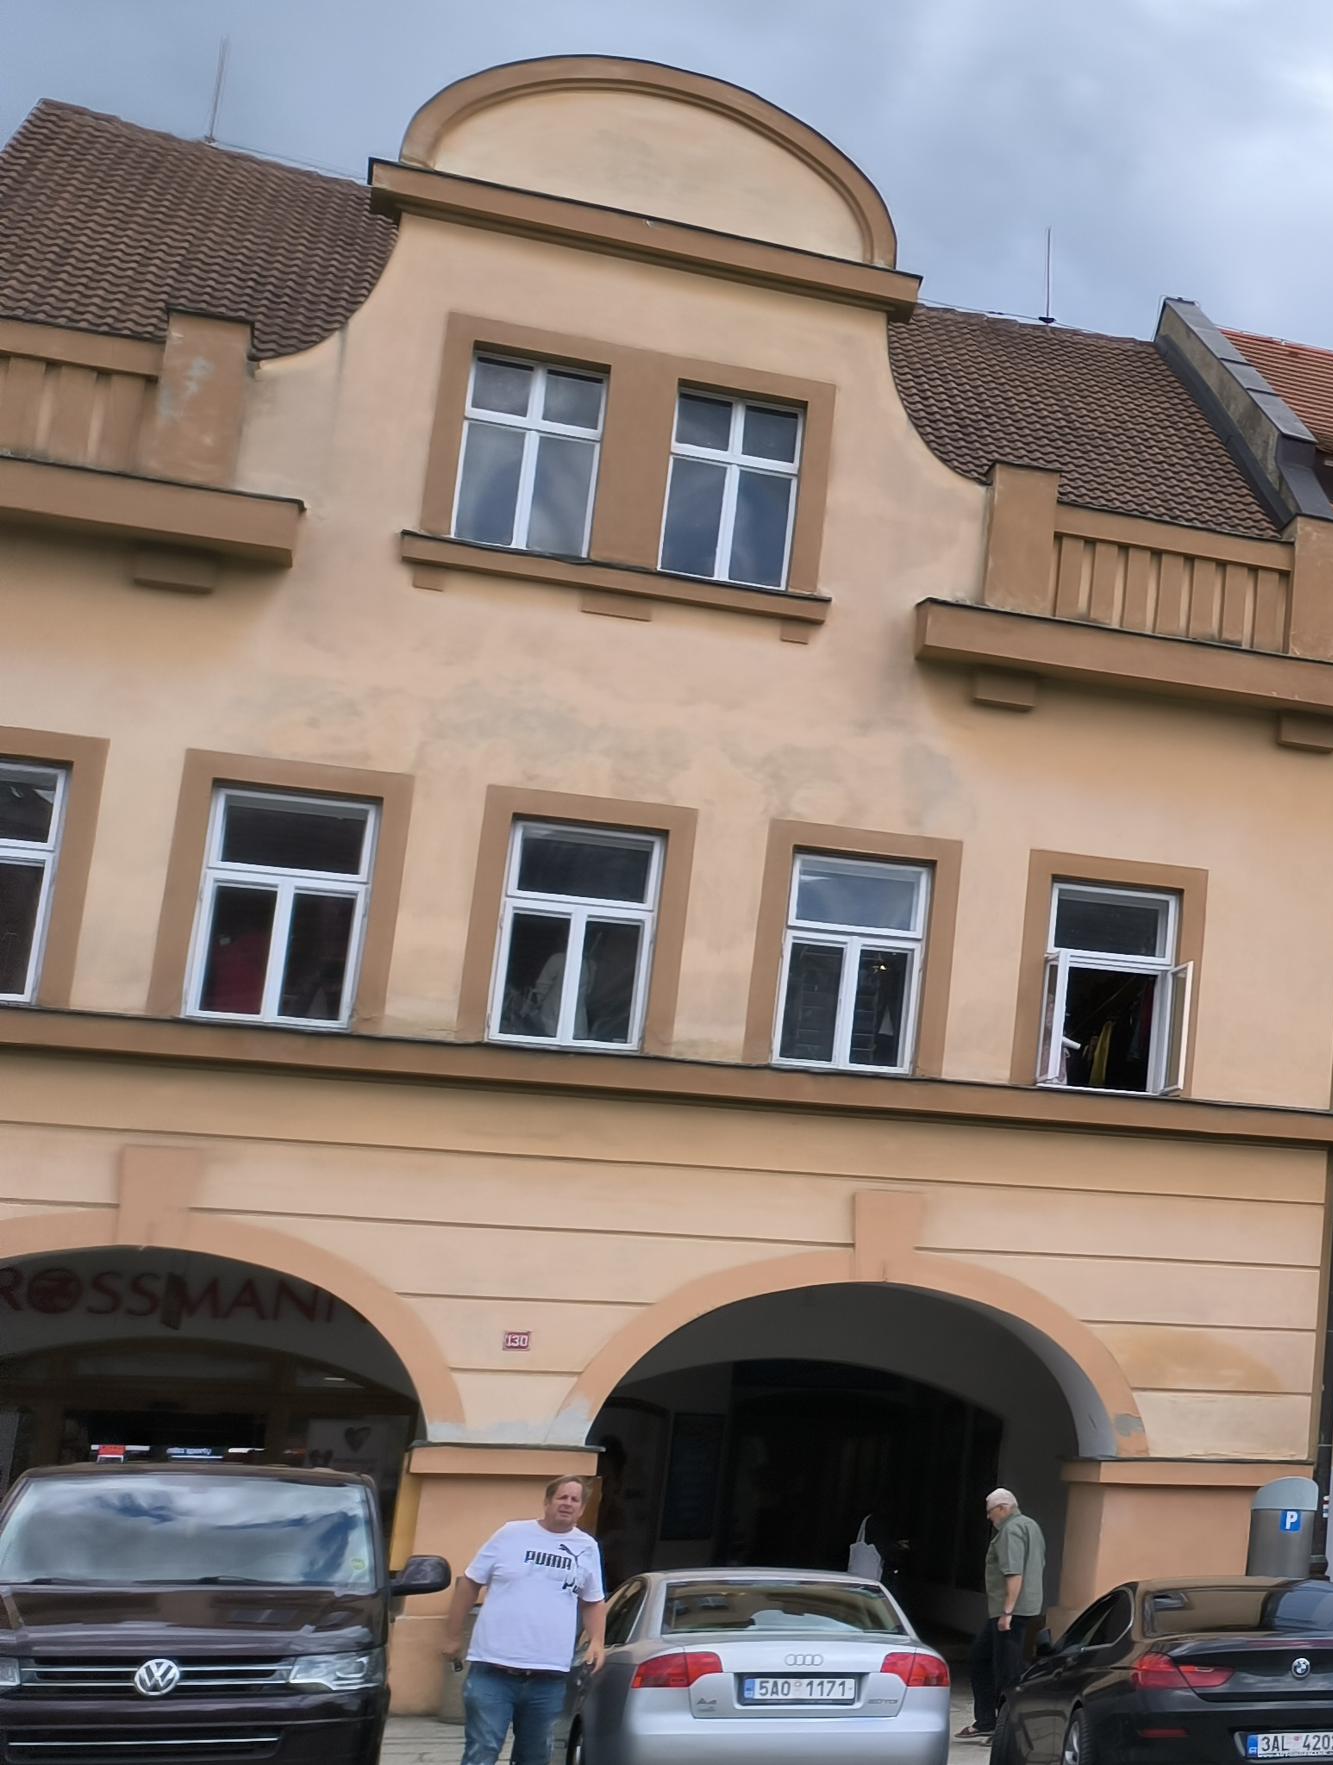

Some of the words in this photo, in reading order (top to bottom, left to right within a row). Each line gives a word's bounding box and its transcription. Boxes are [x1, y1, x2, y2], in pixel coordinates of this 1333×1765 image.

[507, 1334, 529, 1347] 130
[1285, 1511, 1298, 1529] P
[524, 1550, 572, 1570] PUMA
[807, 1680, 846, 1697] 1171
[1261, 1735, 1290, 1752] 3AL
